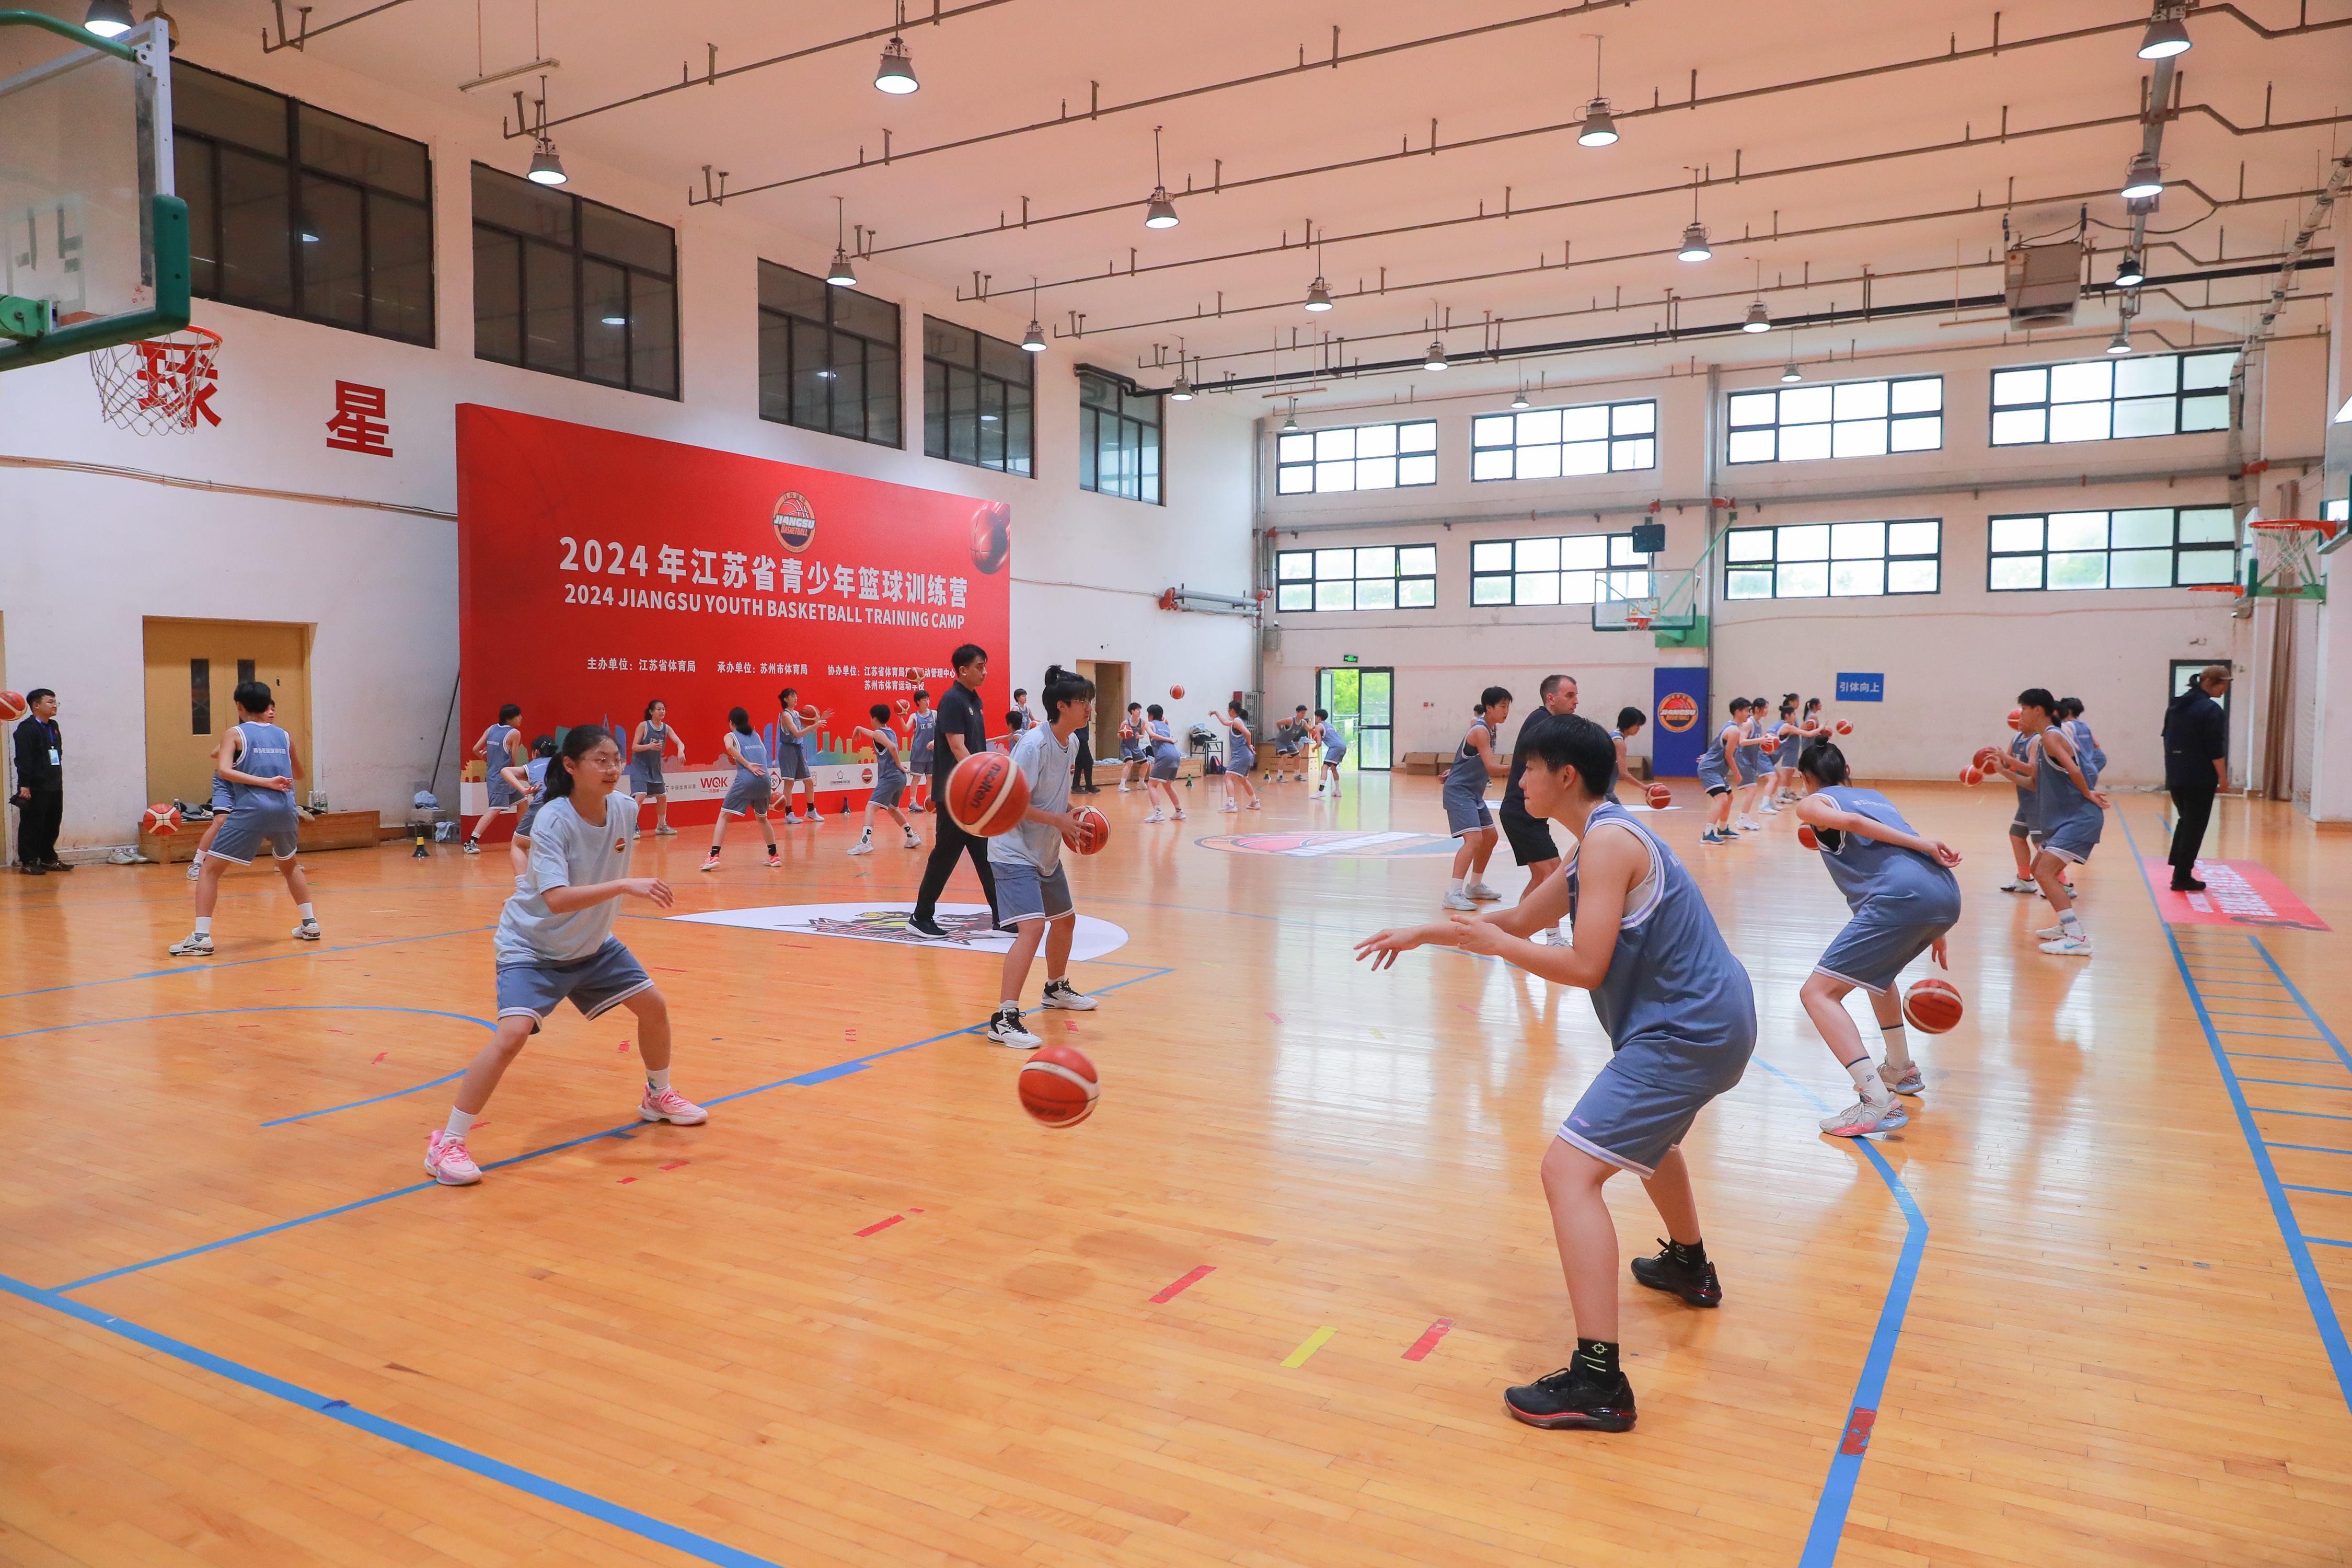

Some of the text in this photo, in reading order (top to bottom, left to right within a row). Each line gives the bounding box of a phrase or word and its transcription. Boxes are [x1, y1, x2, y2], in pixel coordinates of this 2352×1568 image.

[136, 344, 393, 458] 球 星
[774, 514, 815, 529] JIANGSU
[781, 523, 808, 536] BASKETBALL
[559, 536, 968, 608] 2024 年江苏省青少年篮球训练营
[565, 583, 965, 629] 2024 JIANGSU YOUTH BASKETBALL TRAINING CAMP
[1839, 681, 1880, 693] 引体向上
